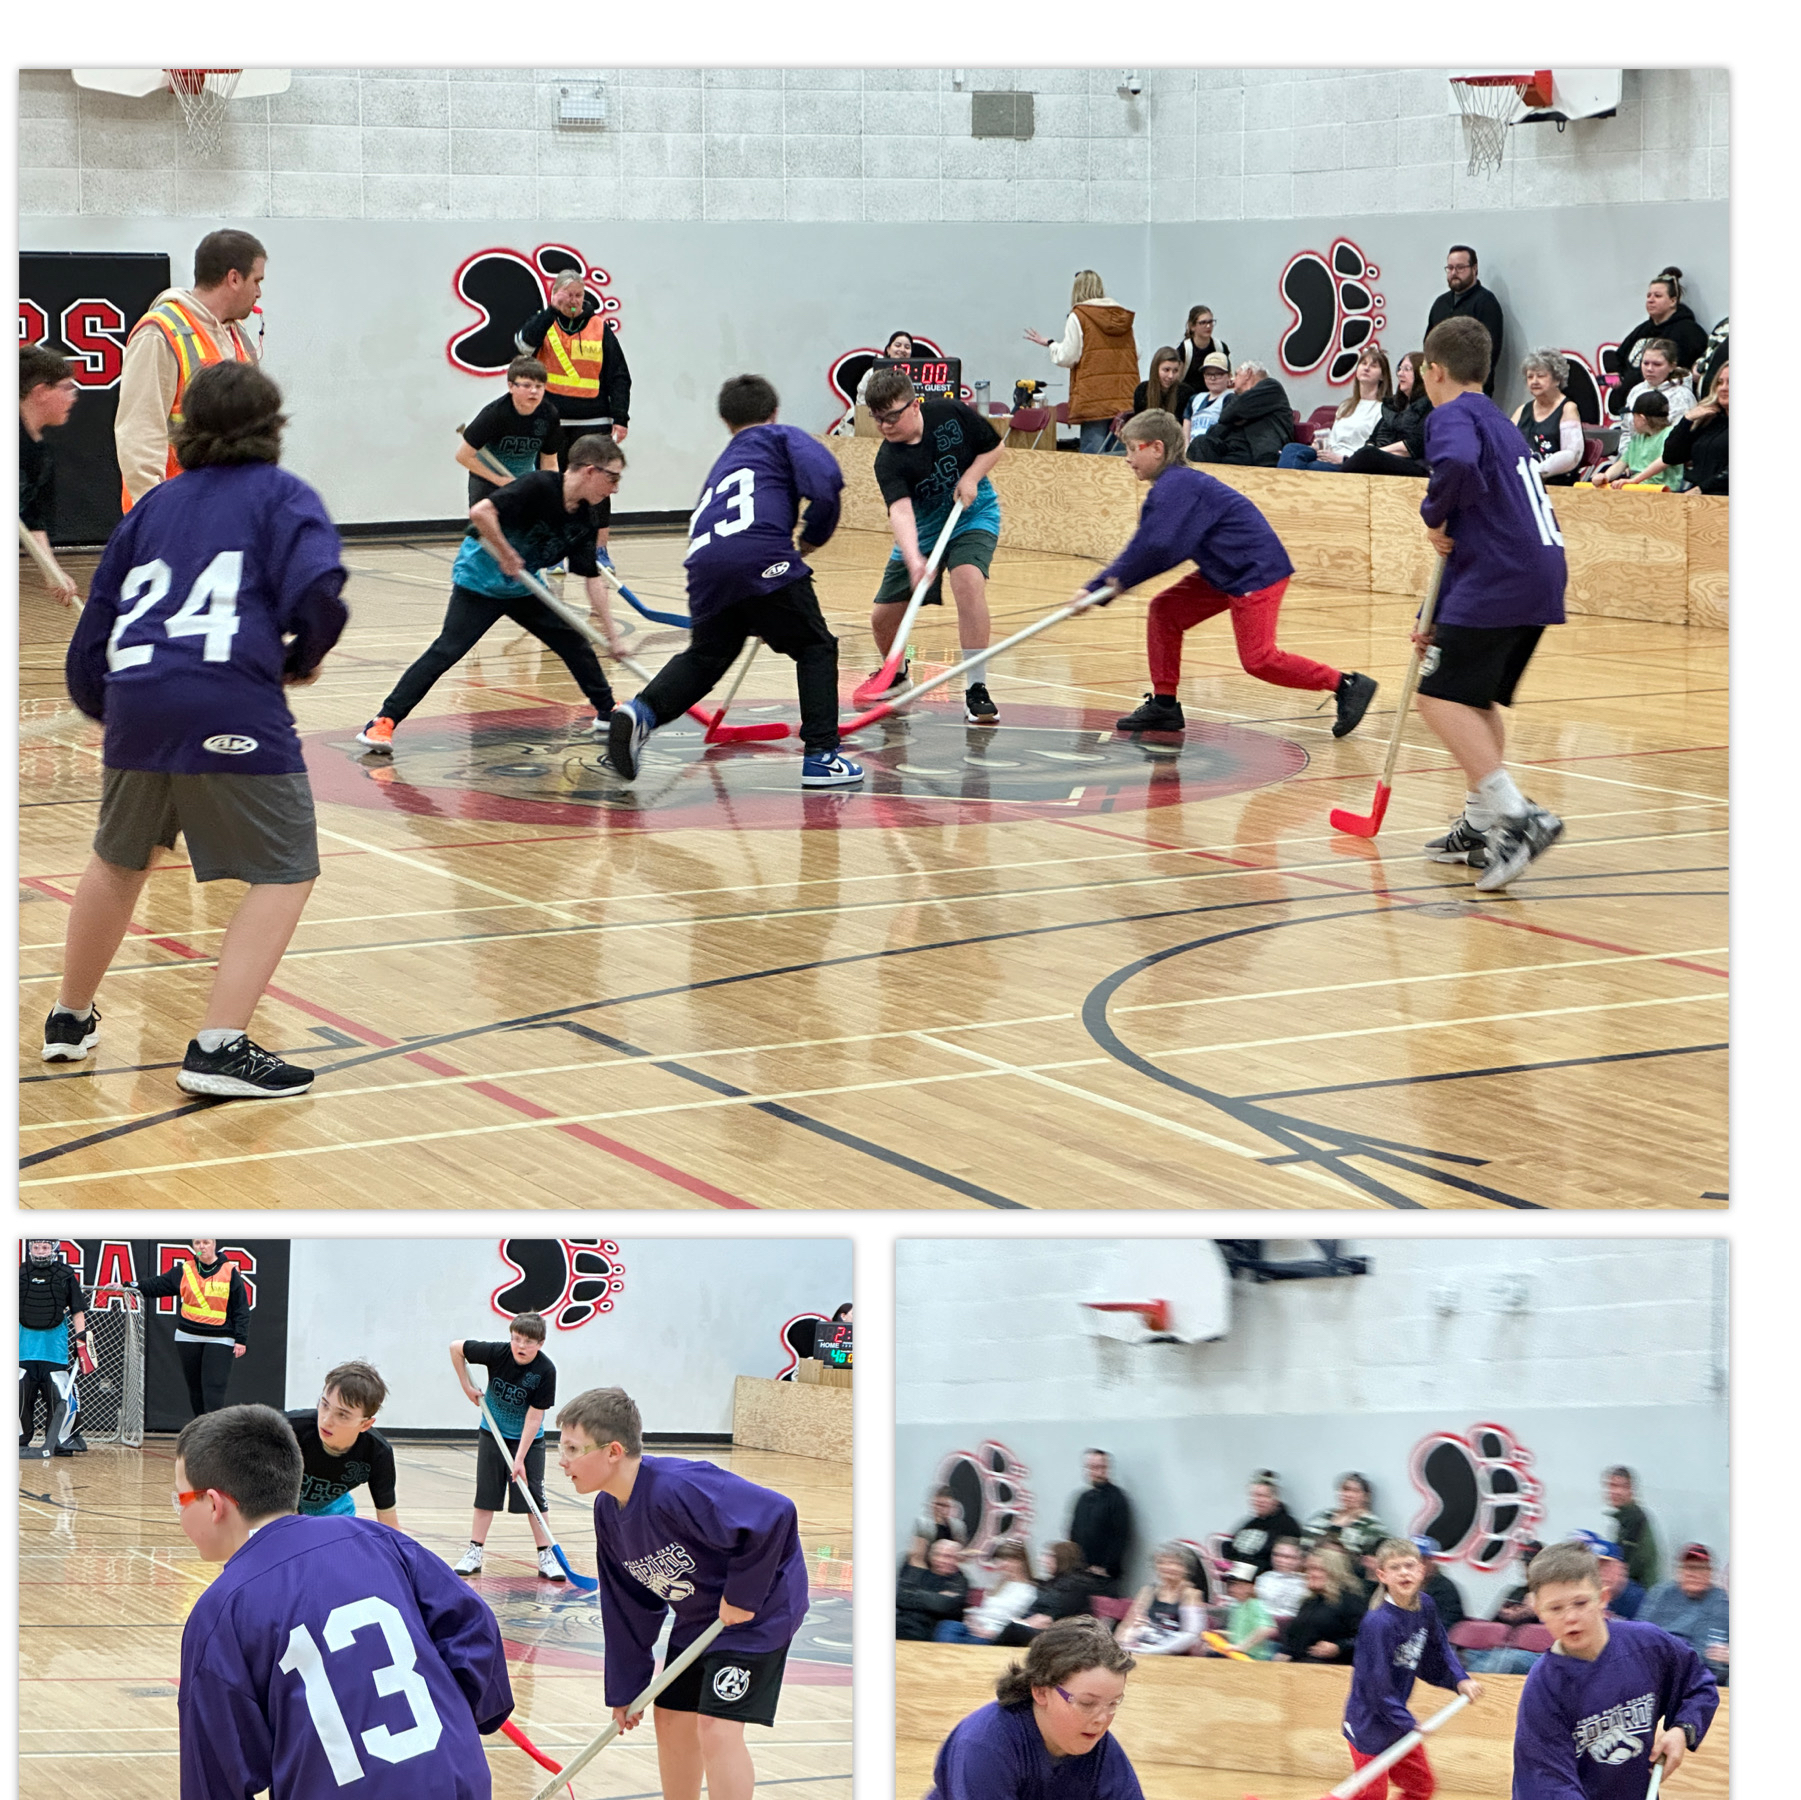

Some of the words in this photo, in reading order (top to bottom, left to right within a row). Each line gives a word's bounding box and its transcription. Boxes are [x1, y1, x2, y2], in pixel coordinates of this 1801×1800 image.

[924, 383, 953, 392] GUEST
[686, 467, 756, 559] 23
[106, 550, 245, 673] 24
[492, 1377, 528, 1407] CES
[278, 1596, 443, 1787] 13
